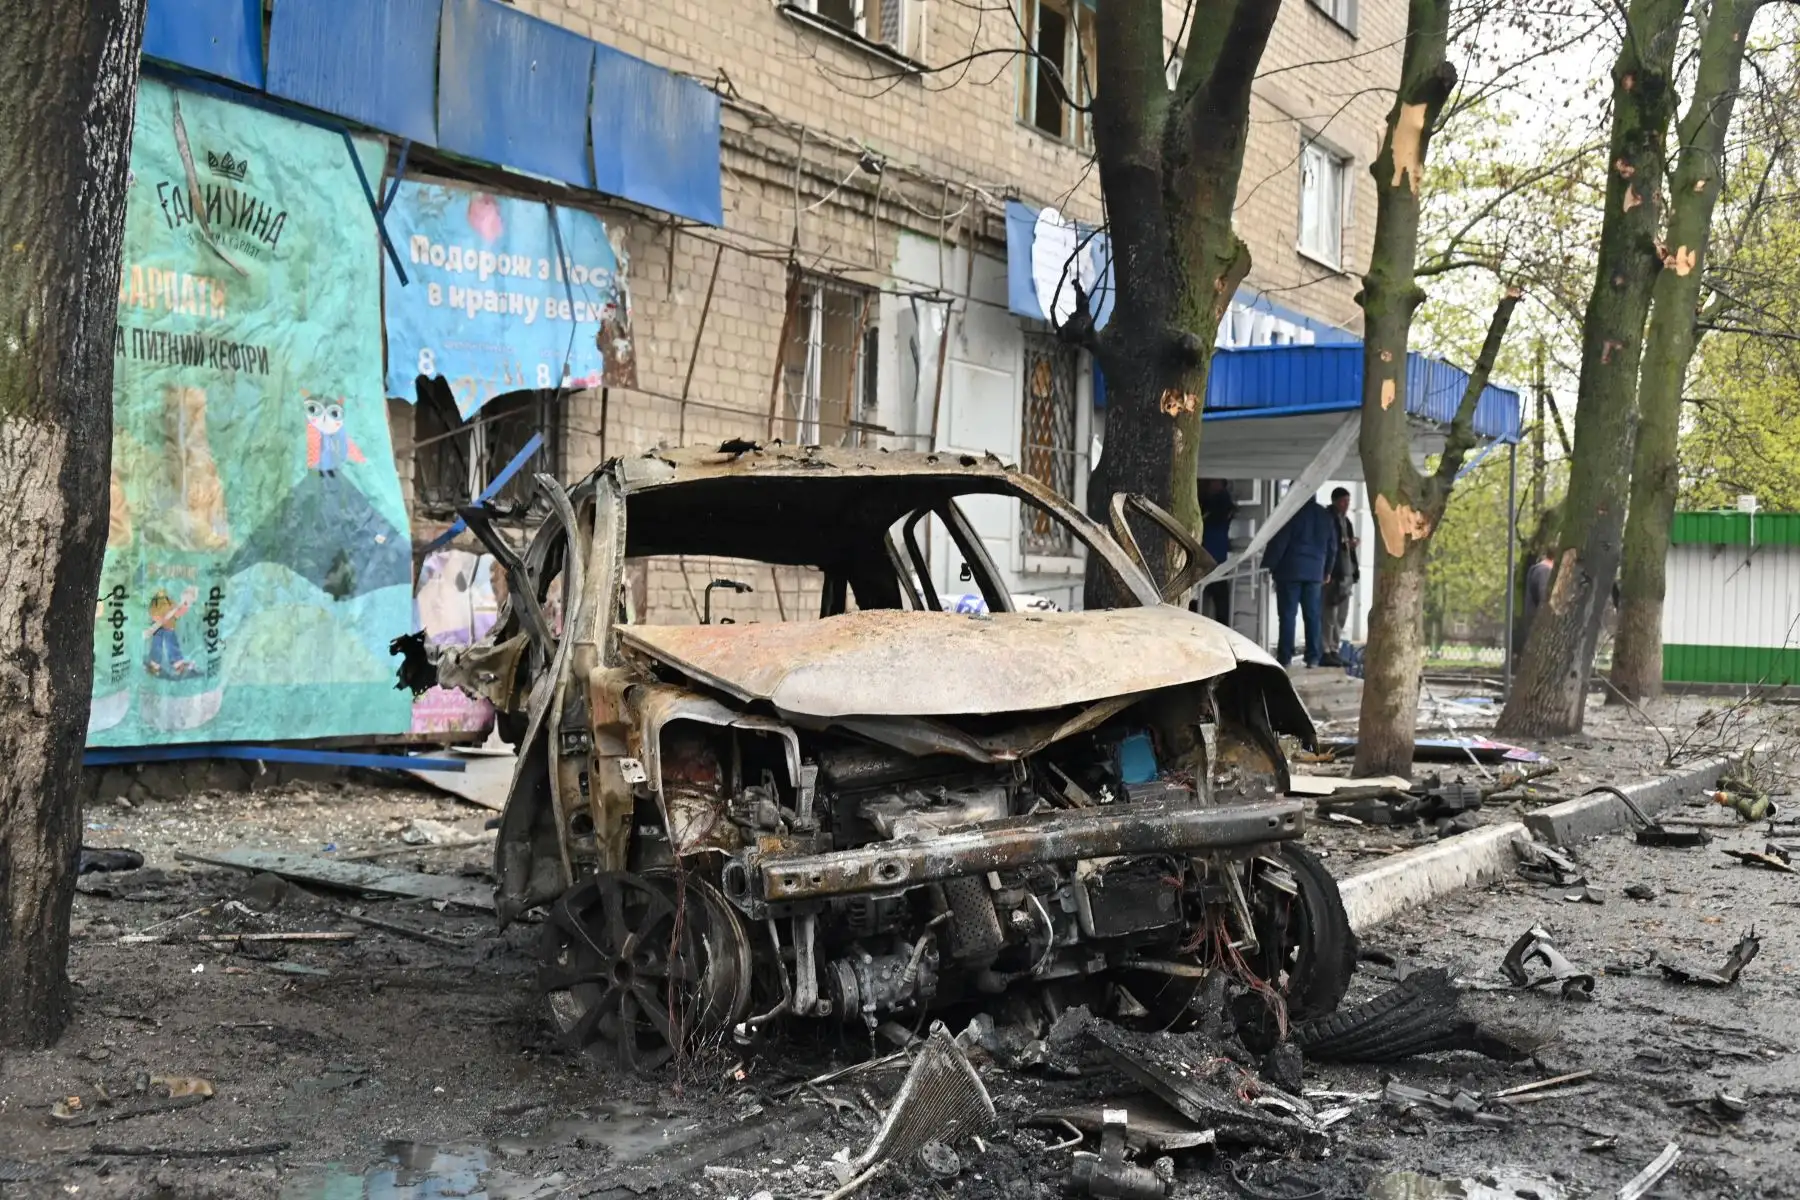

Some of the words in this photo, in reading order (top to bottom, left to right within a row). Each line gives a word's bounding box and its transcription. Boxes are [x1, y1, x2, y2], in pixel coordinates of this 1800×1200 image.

[410, 235, 532, 282] Подорож
[538, 258, 549, 281] з
[428, 283, 442, 306] в
[449, 284, 540, 324] країну
[132, 327, 205, 367] ПИТНИЙ
[209, 338, 269, 376] КЕФІРИ
[108, 584, 129, 657] кефір
[203, 586, 226, 654] кефір
